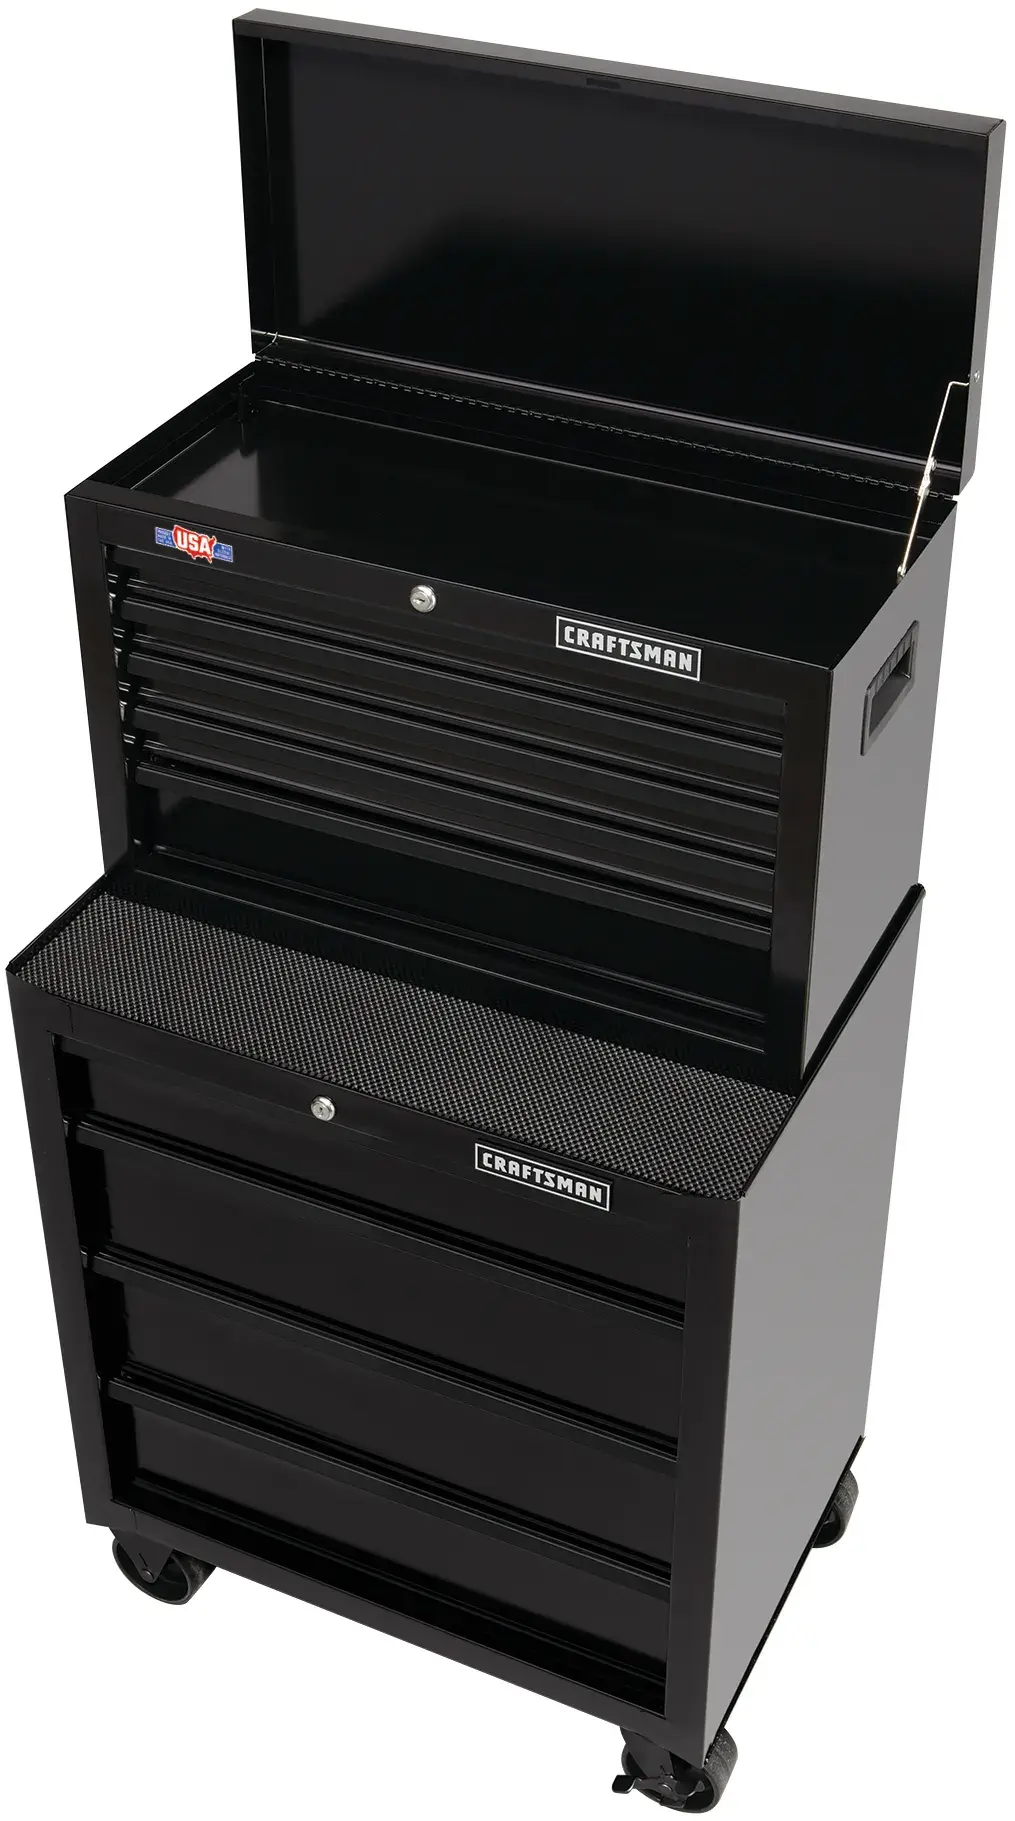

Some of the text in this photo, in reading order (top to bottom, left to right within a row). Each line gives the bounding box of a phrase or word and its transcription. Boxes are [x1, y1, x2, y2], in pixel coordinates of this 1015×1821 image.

[177, 530, 211, 554] USA
[564, 625, 692, 672] CRAFTSMAN
[483, 1152, 602, 1203] CRAFTSMAN
